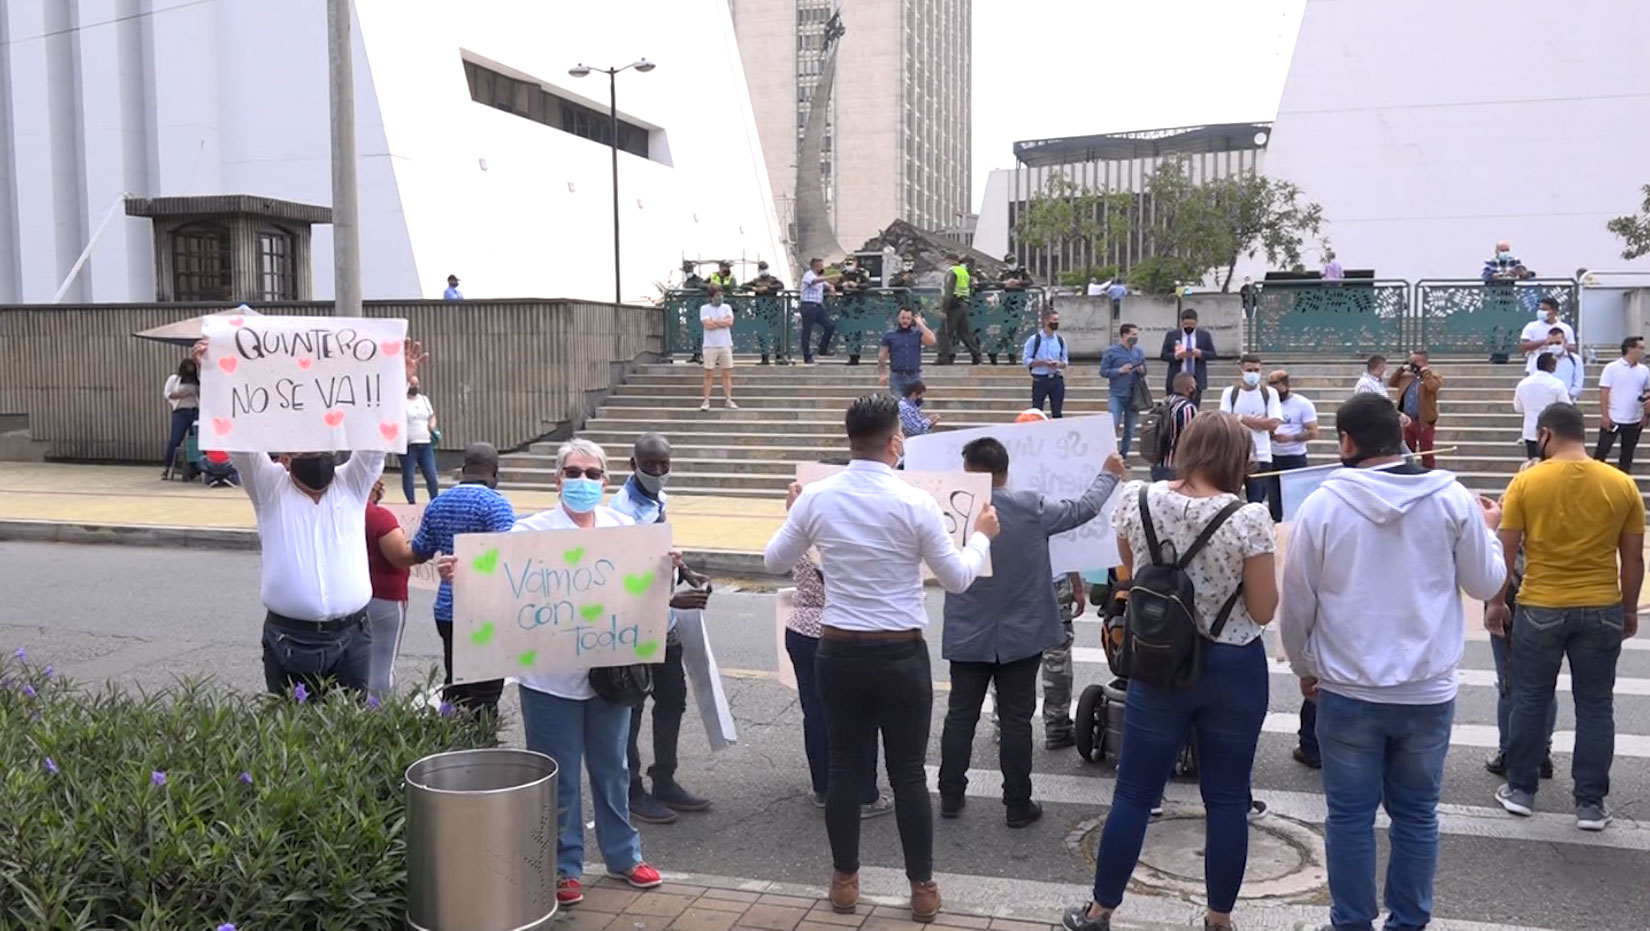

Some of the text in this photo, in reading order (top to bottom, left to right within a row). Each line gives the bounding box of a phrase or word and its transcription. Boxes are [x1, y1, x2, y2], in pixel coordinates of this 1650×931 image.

[235, 327, 377, 361] QUINTERO
[232, 384, 269, 418] NO
[276, 378, 304, 411] SE
[504, 558, 615, 599] Vamos
[518, 601, 574, 630] con
[561, 614, 639, 656] Toda
